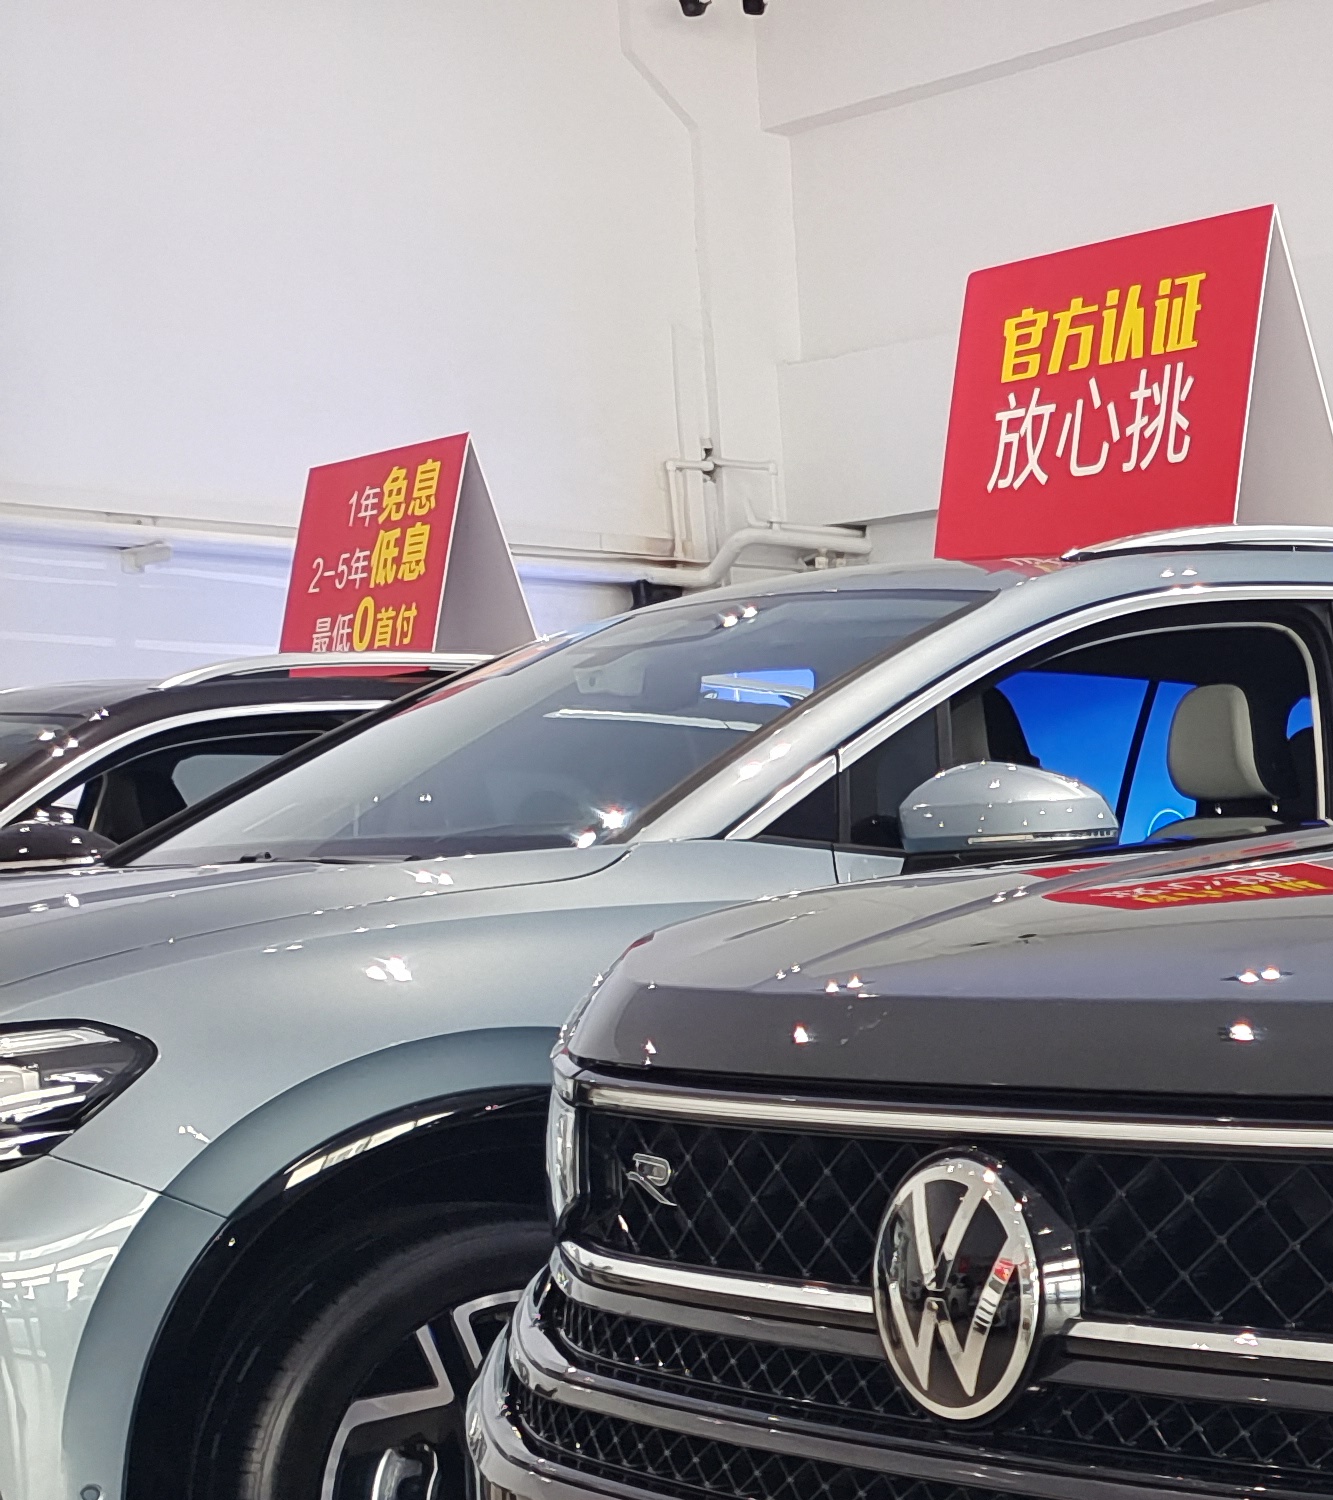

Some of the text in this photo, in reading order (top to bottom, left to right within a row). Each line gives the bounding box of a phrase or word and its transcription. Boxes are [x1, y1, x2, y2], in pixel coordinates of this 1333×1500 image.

[1000, 272, 1207, 384] 官方认证
[986, 361, 1195, 494] 放心挑
[348, 458, 442, 527] 1年免息
[307, 521, 432, 594] 2-5年低息
[311, 595, 418, 653] 最低0首付
[625, 1152, 678, 1207] R
[874, 1158, 1039, 1420] VW
